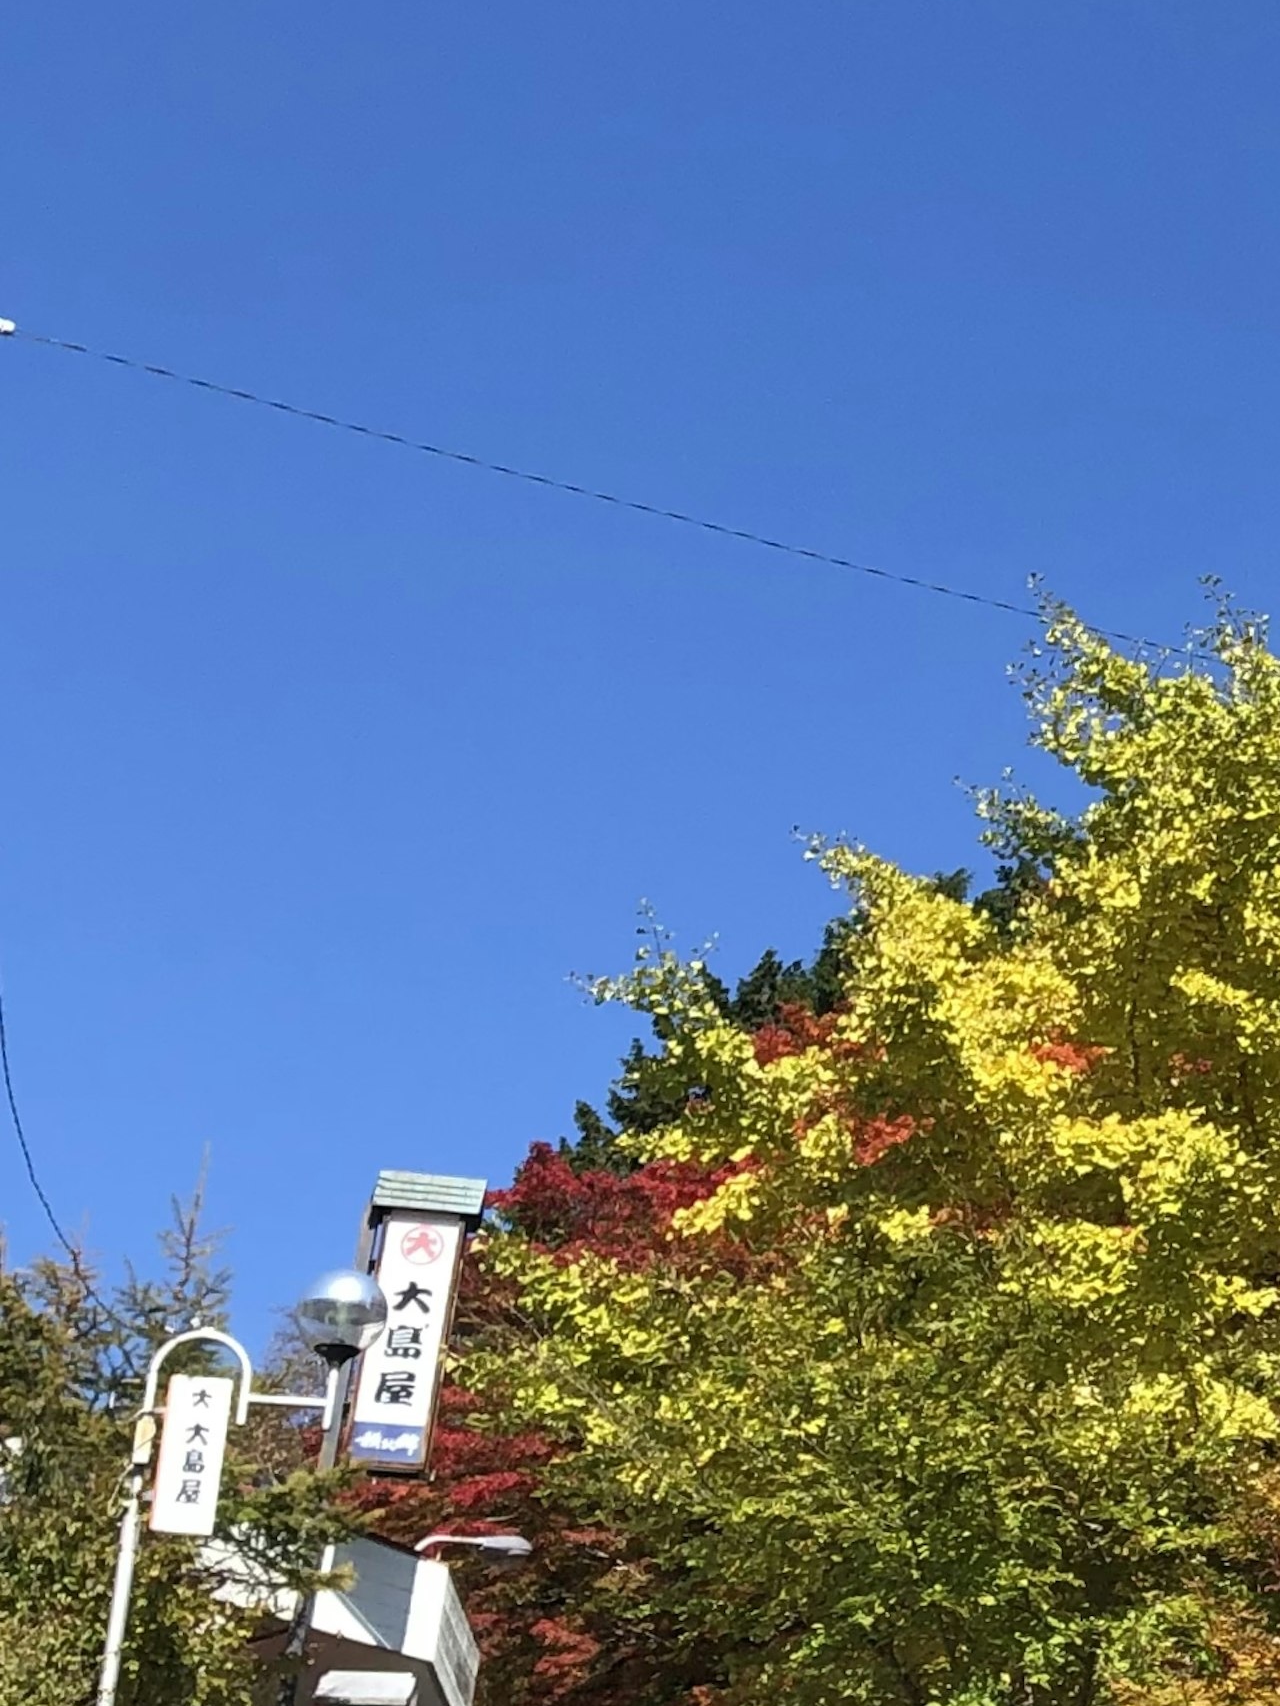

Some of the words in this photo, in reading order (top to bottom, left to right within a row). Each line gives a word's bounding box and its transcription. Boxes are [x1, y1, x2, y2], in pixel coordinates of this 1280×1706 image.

[374, 1282, 432, 1406] 大島屋
[176, 1423, 209, 1504] 大島屋
